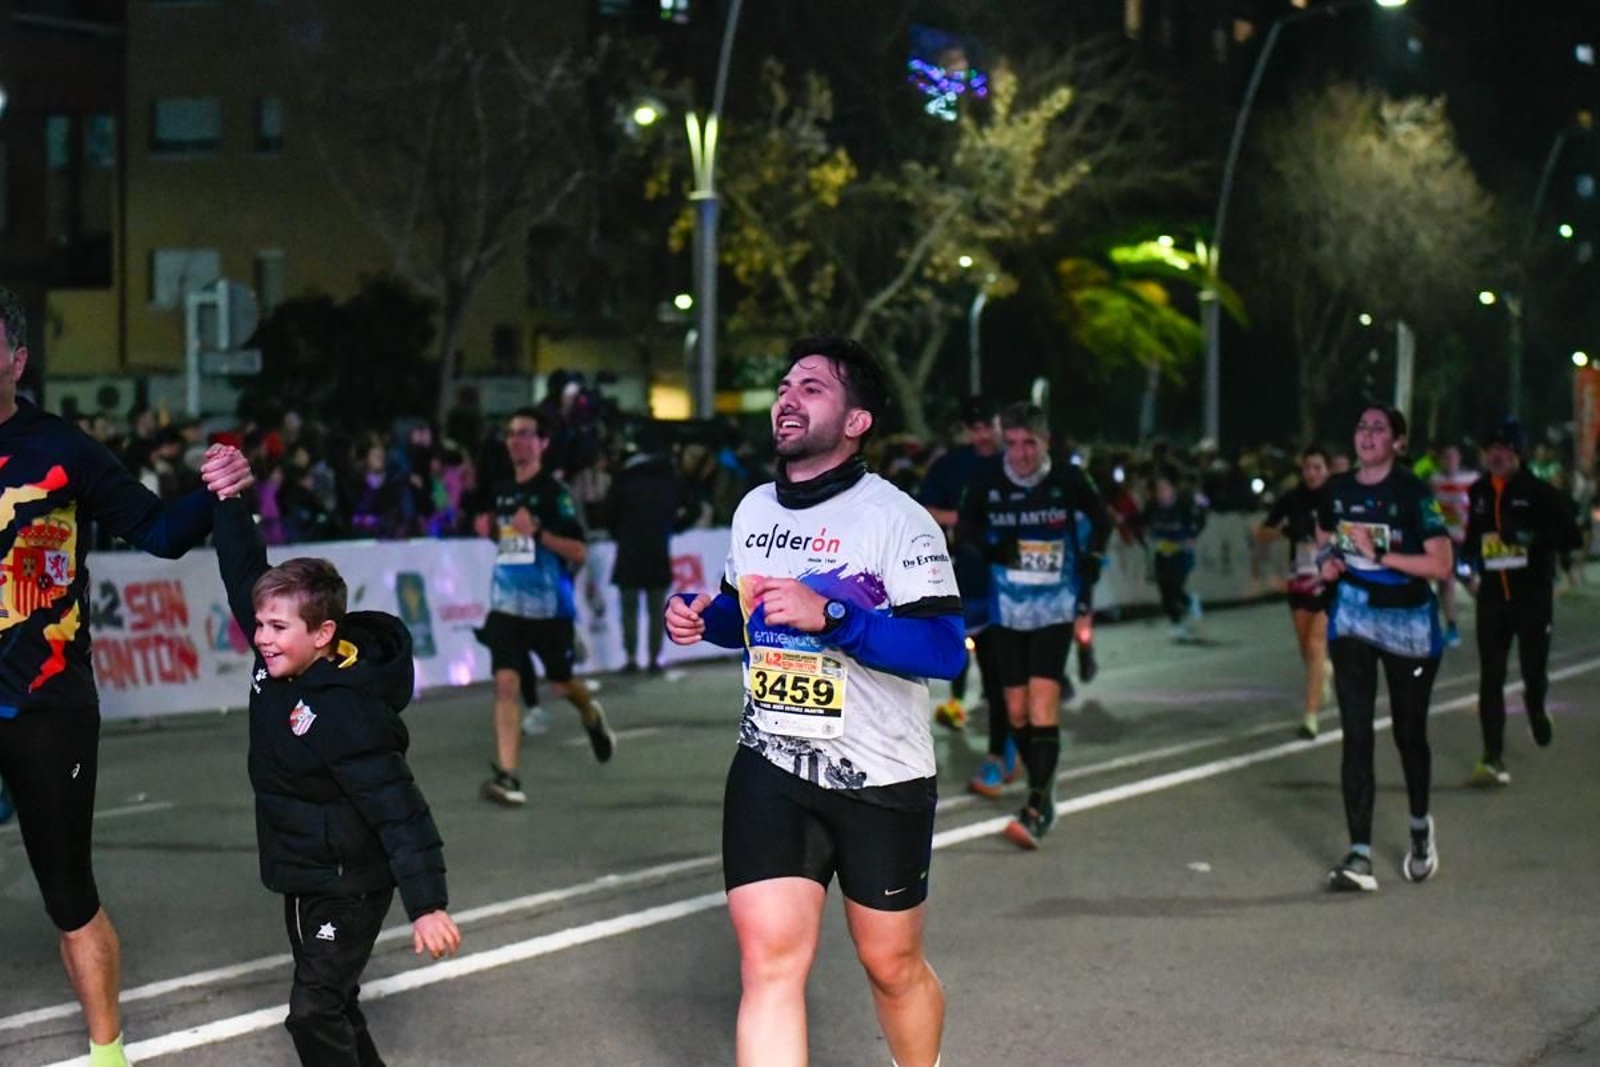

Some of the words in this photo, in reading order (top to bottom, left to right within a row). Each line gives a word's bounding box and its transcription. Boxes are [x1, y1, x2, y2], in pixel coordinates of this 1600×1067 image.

[988, 511, 1016, 526] SAN
[745, 523, 841, 558] calderón
[124, 579, 189, 632] SAN
[92, 633, 200, 692] ANTON
[755, 671, 834, 706] 3459
